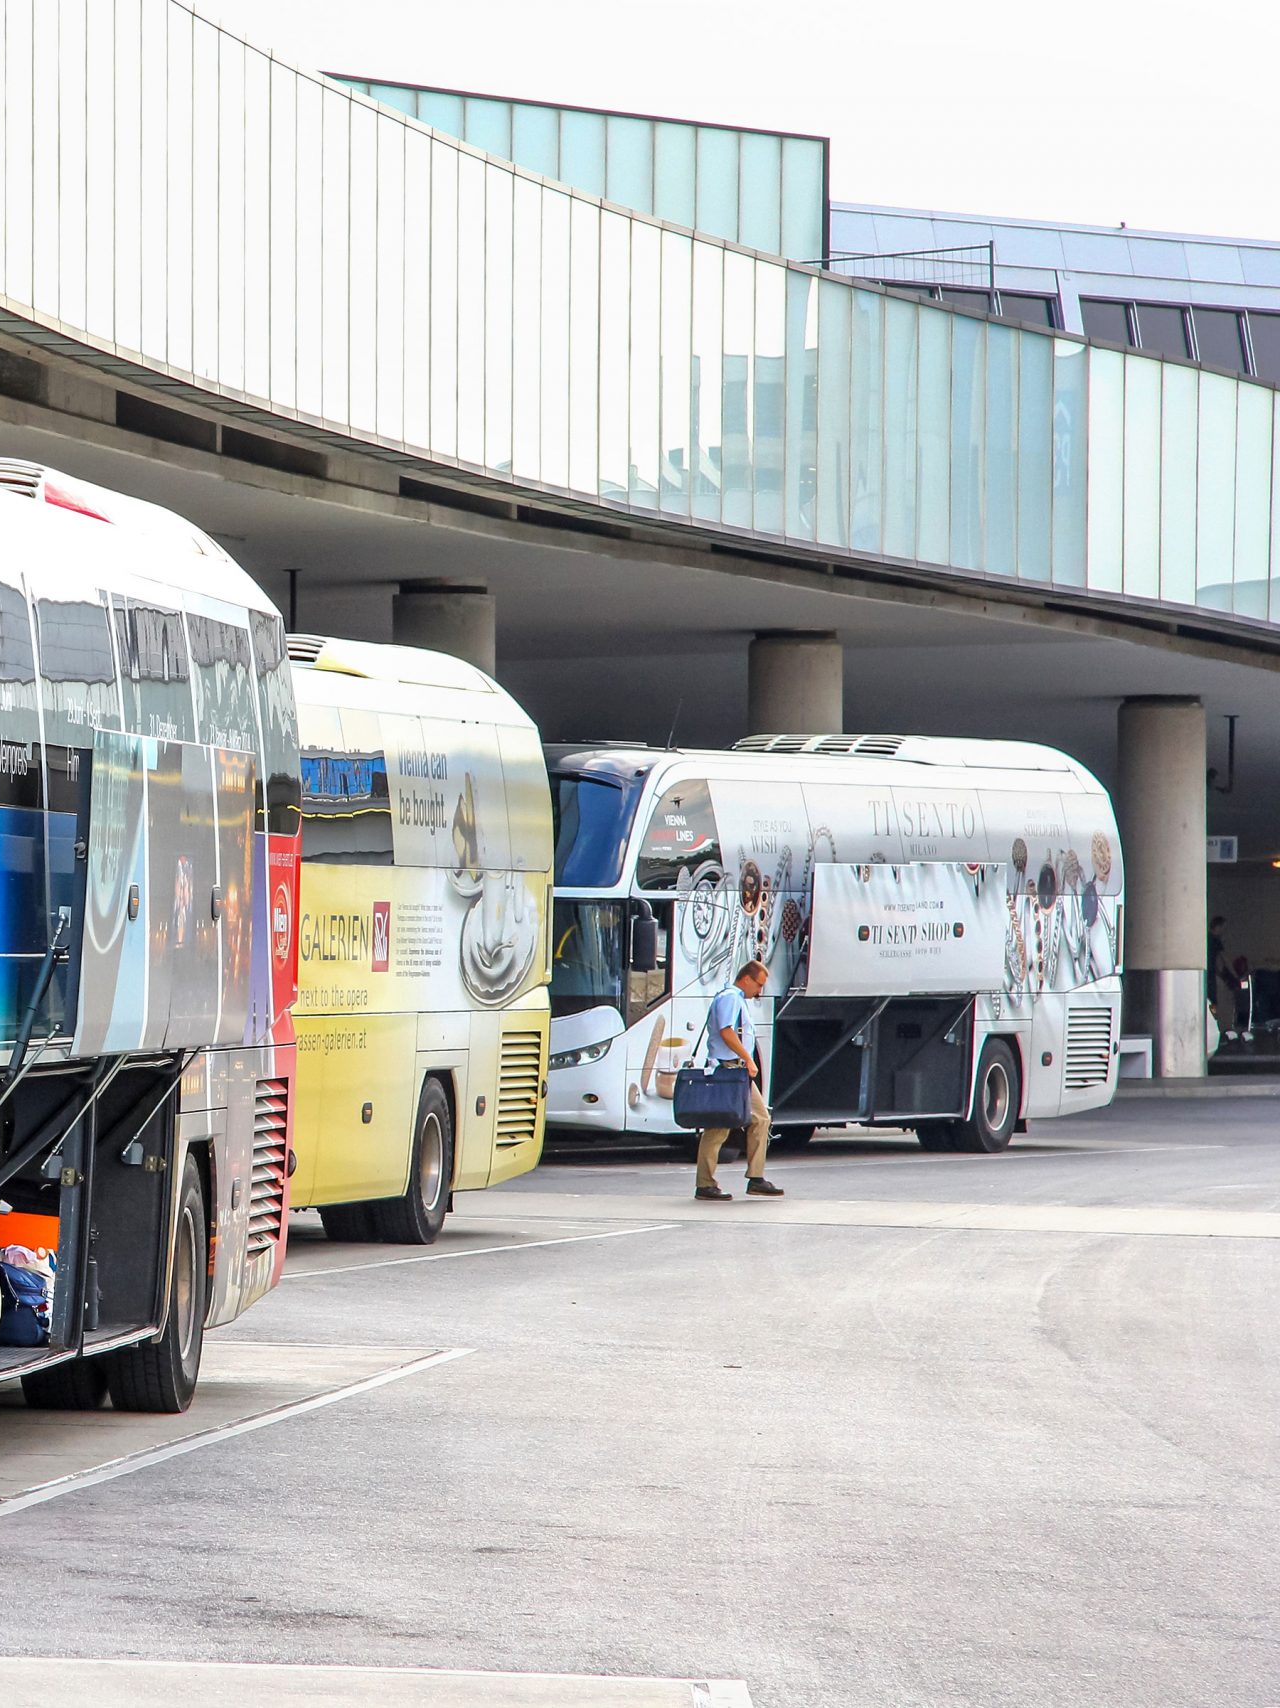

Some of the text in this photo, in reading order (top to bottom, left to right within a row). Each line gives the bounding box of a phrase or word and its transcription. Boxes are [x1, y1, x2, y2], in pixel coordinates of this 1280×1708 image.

[430, 752, 448, 780] can
[399, 788, 447, 836] be bought.
[664, 814, 687, 826] VIENNA
[868, 799, 976, 839] TI SENTO
[751, 835, 778, 854] WISH
[300, 913, 369, 962] GALERIEN
[871, 924, 883, 945] TI
[921, 921, 950, 942] SHOP
[300, 984, 368, 1011] next to the opera
[297, 1028, 367, 1056] rassen-galerien.at
